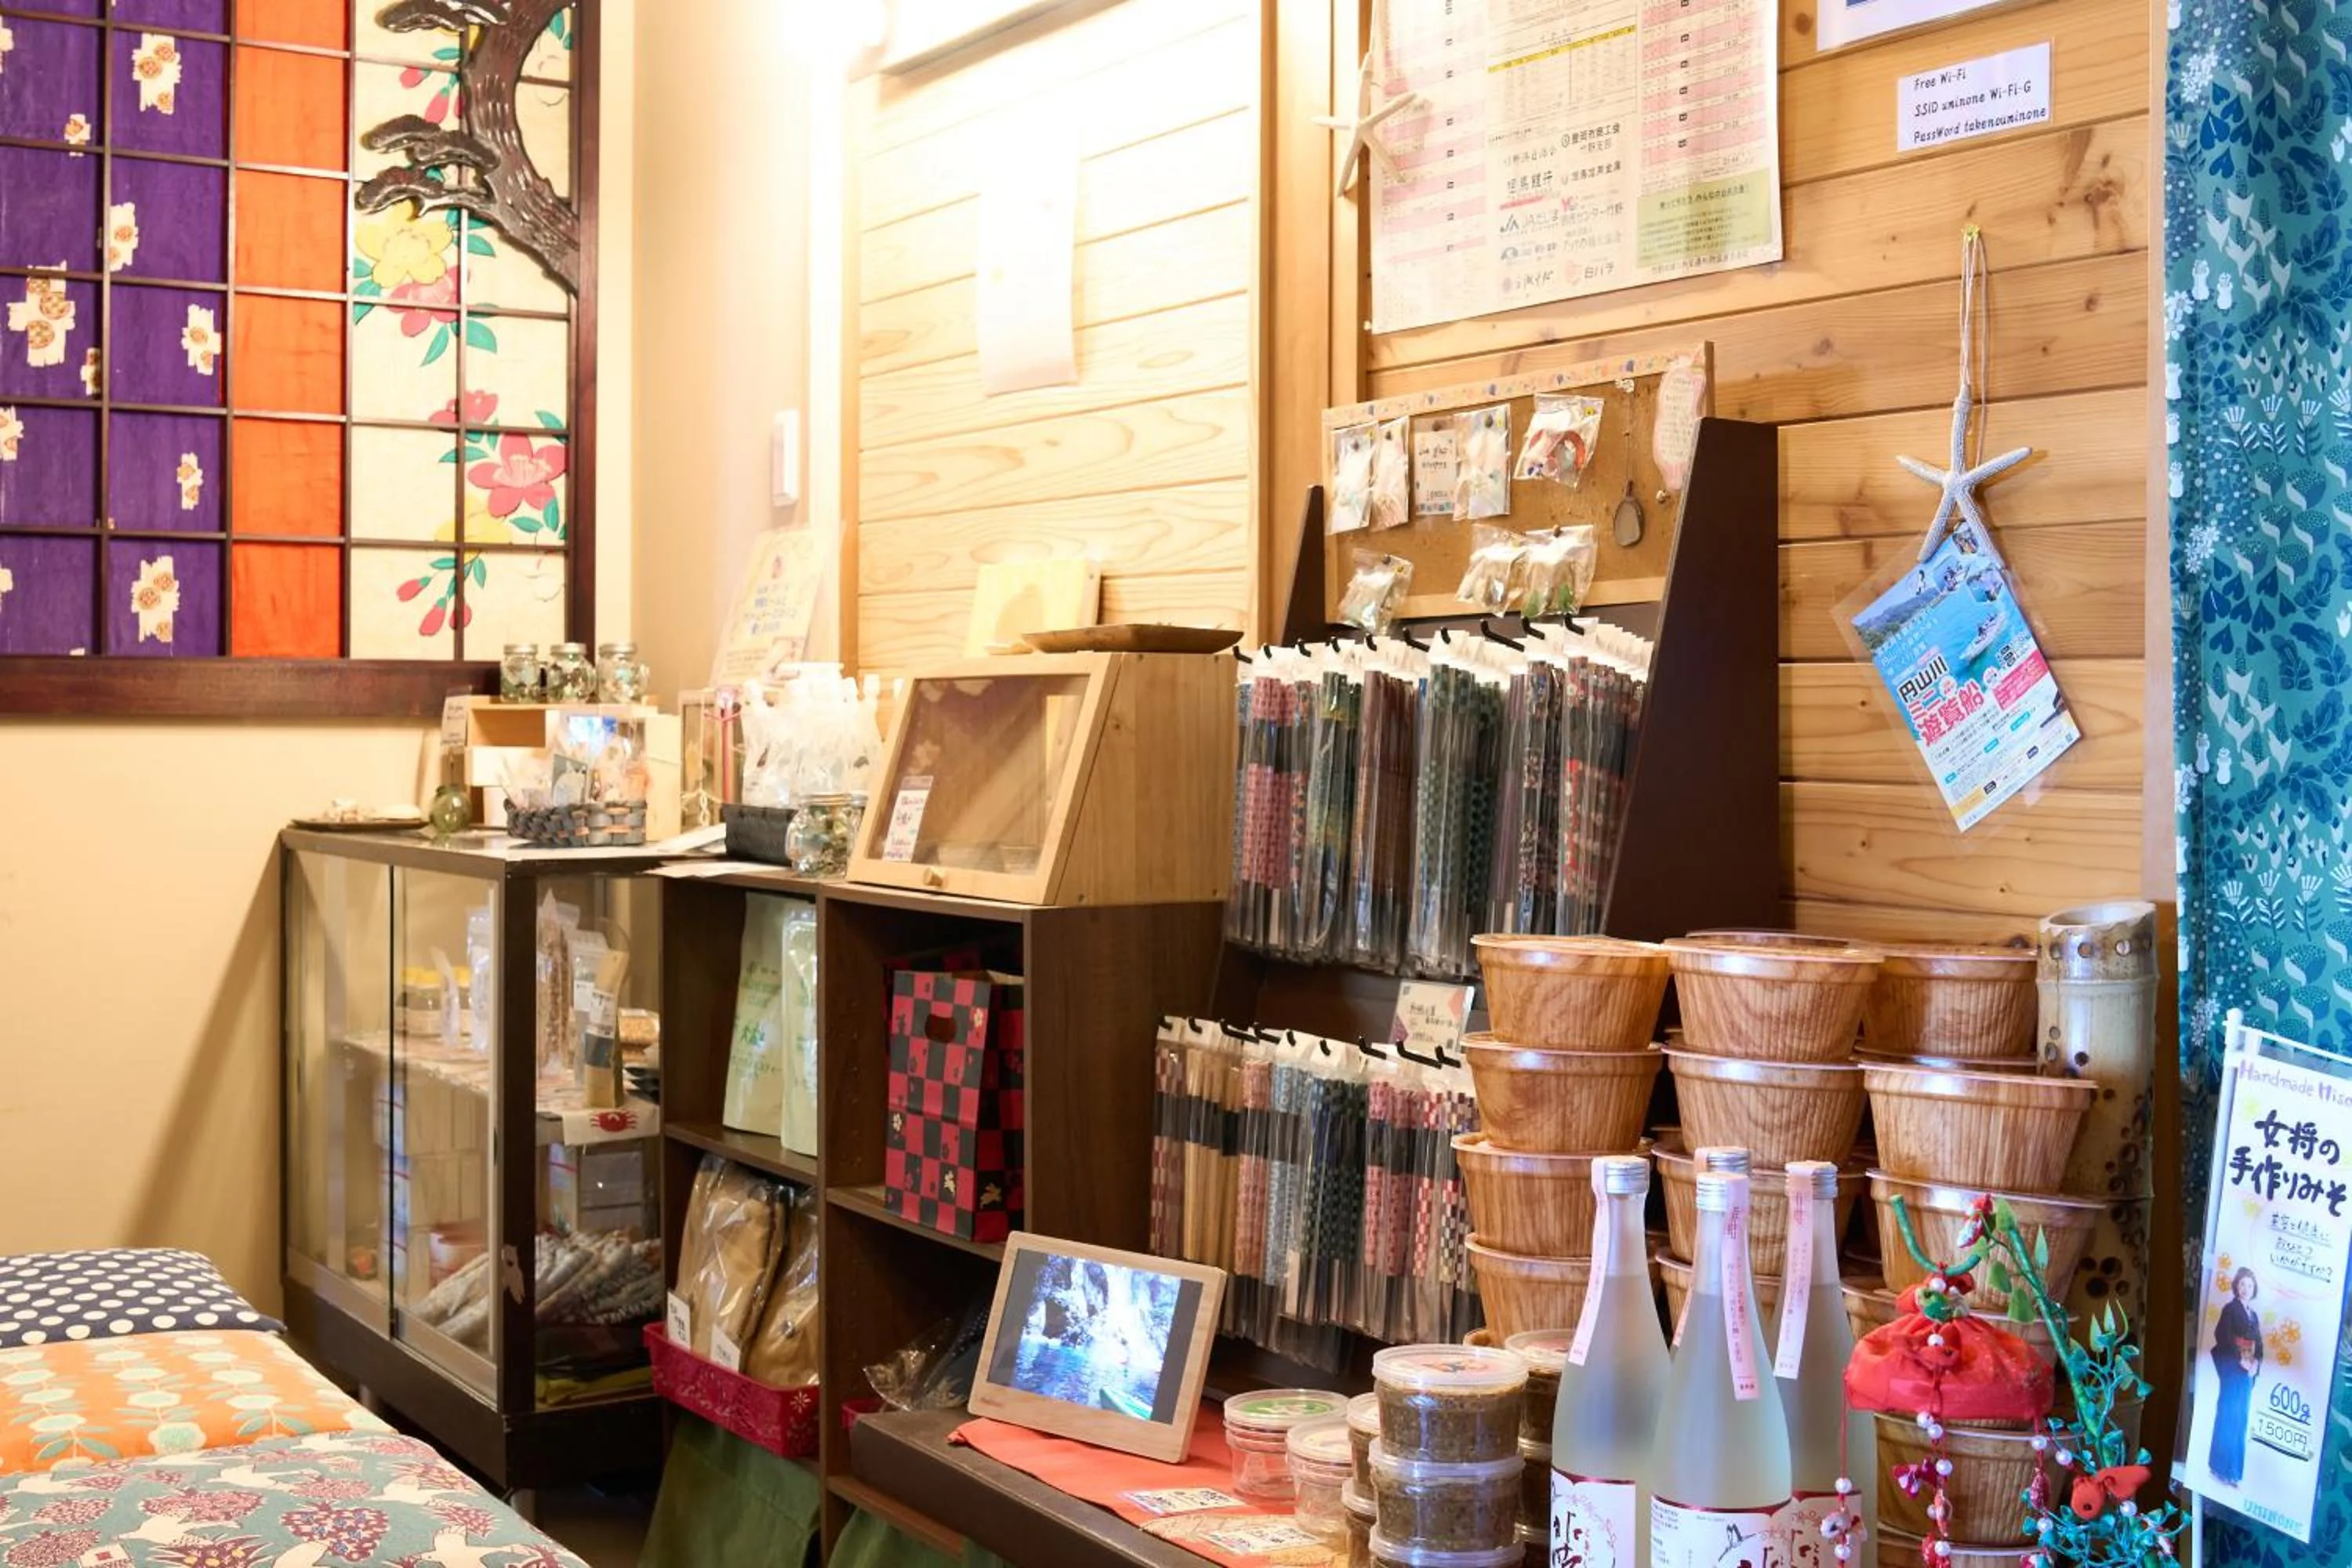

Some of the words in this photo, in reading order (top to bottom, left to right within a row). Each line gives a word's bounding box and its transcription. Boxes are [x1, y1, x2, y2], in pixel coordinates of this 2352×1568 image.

[1914, 78, 1936, 91] Free
[1940, 67, 1966, 84] Wi-Fi
[1914, 101, 1939, 117] SSID
[1899, 656, 1948, 702] 円山川
[1919, 681, 1984, 746] 遊覧船
[2239, 1059, 2315, 1096] Handmade
[2254, 1109, 2340, 1166] 女将の
[2229, 1145, 2347, 1218] 手作りみそ
[2270, 1382, 2311, 1424] 600g
[2258, 1417, 2308, 1453] 1500円
